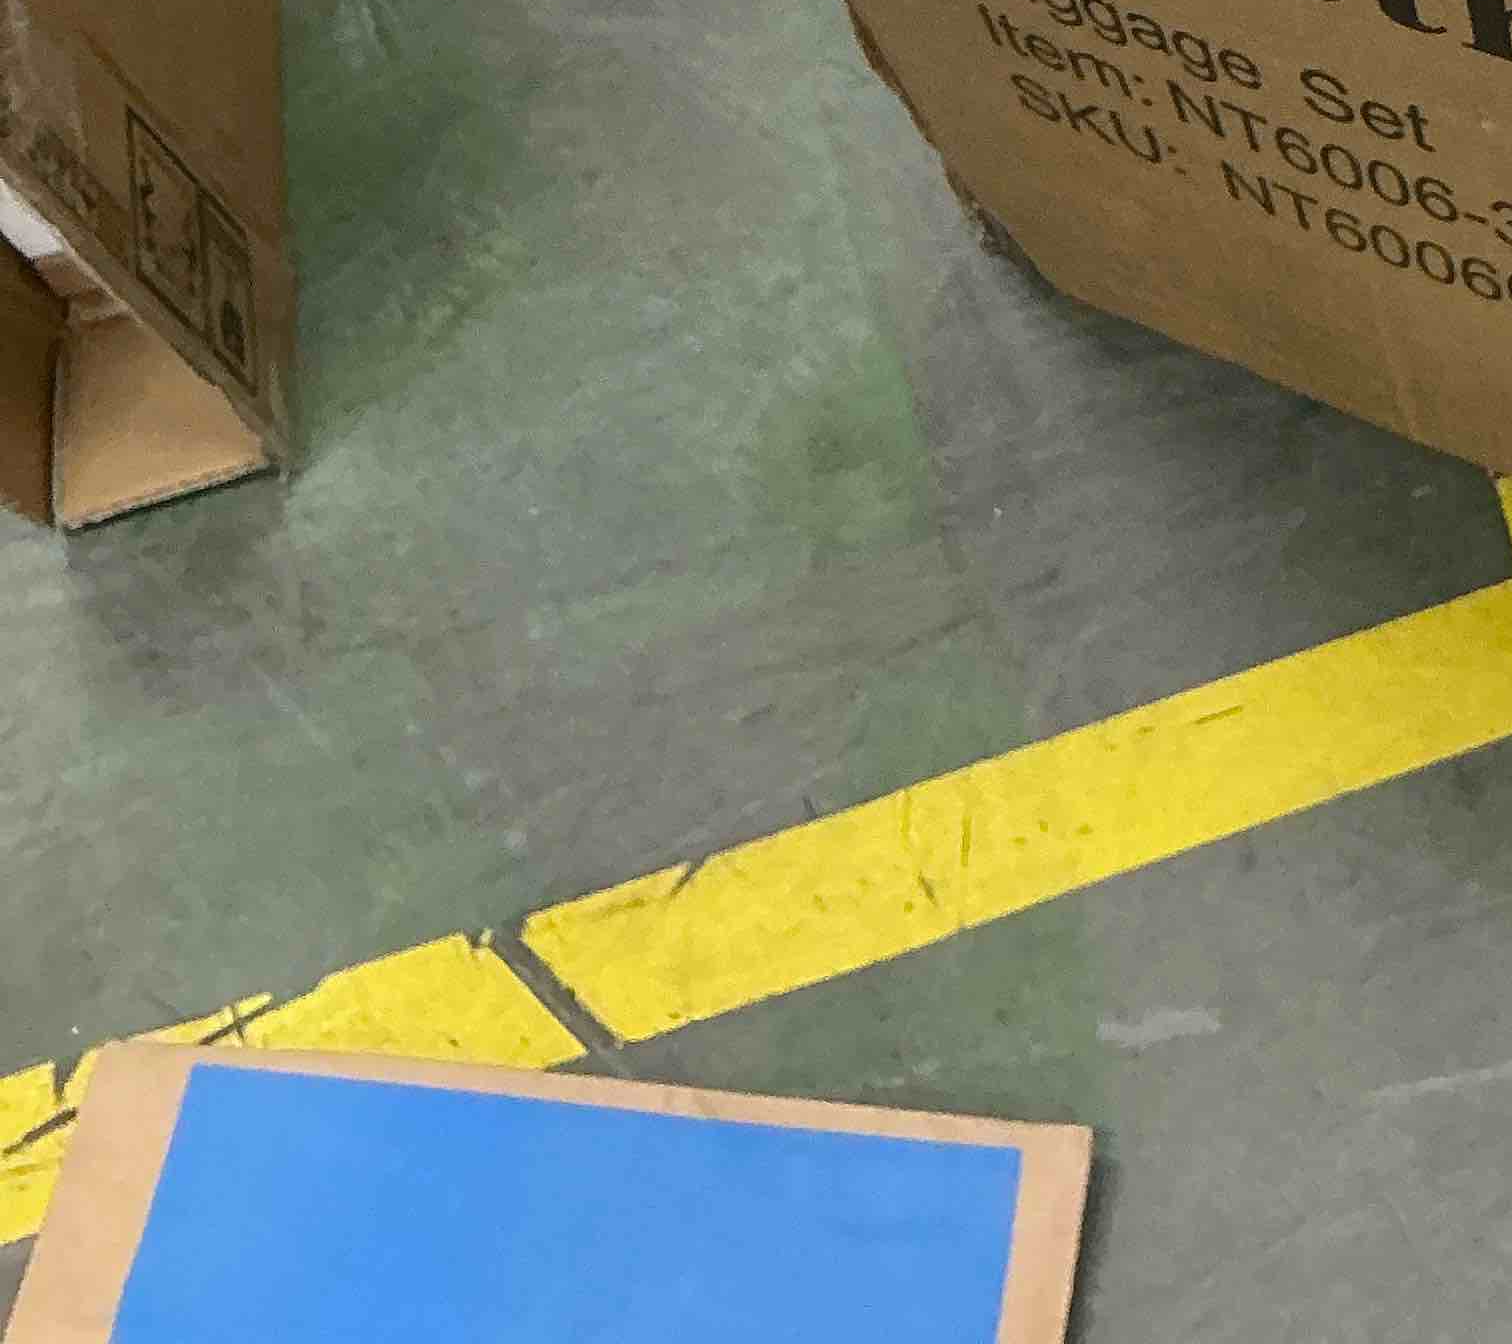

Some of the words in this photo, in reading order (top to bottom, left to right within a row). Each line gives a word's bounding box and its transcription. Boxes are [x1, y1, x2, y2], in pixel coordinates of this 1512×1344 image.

[975, 1, 1153, 108] Item:
[1007, 71, 1186, 176] SKU:
[1301, 66, 1435, 152] Set
